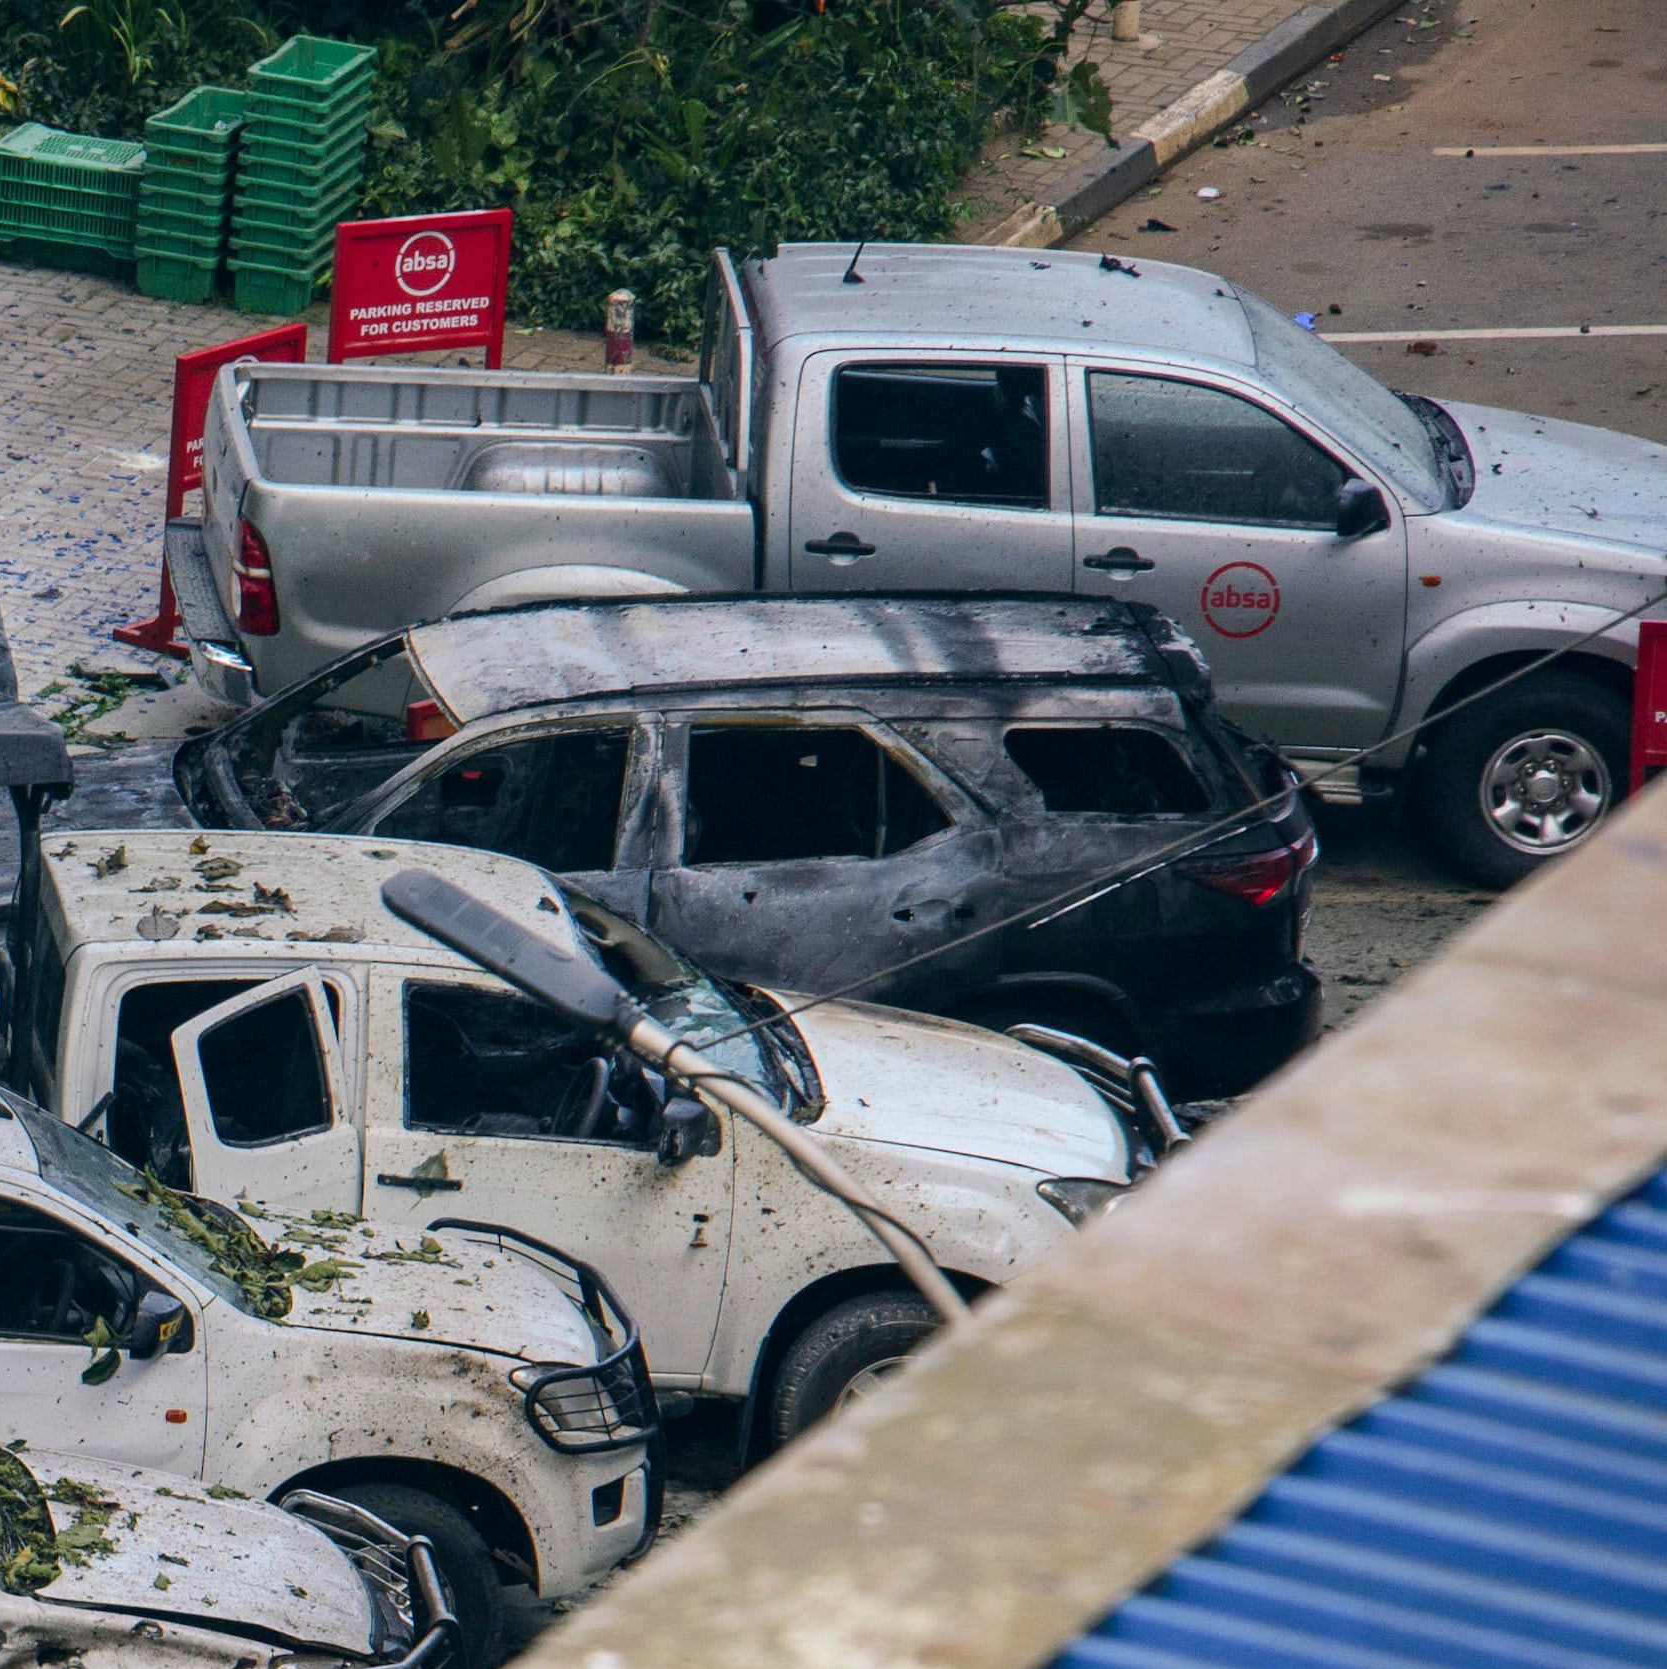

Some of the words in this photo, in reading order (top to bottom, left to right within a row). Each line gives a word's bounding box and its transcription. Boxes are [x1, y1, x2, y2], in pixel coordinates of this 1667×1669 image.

[402, 250, 448, 273] absa
[349, 302, 412, 320] PARKING
[415, 296, 490, 314] RESERVED
[360, 321, 389, 336] FOR
[392, 314, 478, 332] CUSTOMERS
[1210, 584, 1271, 609] absa
